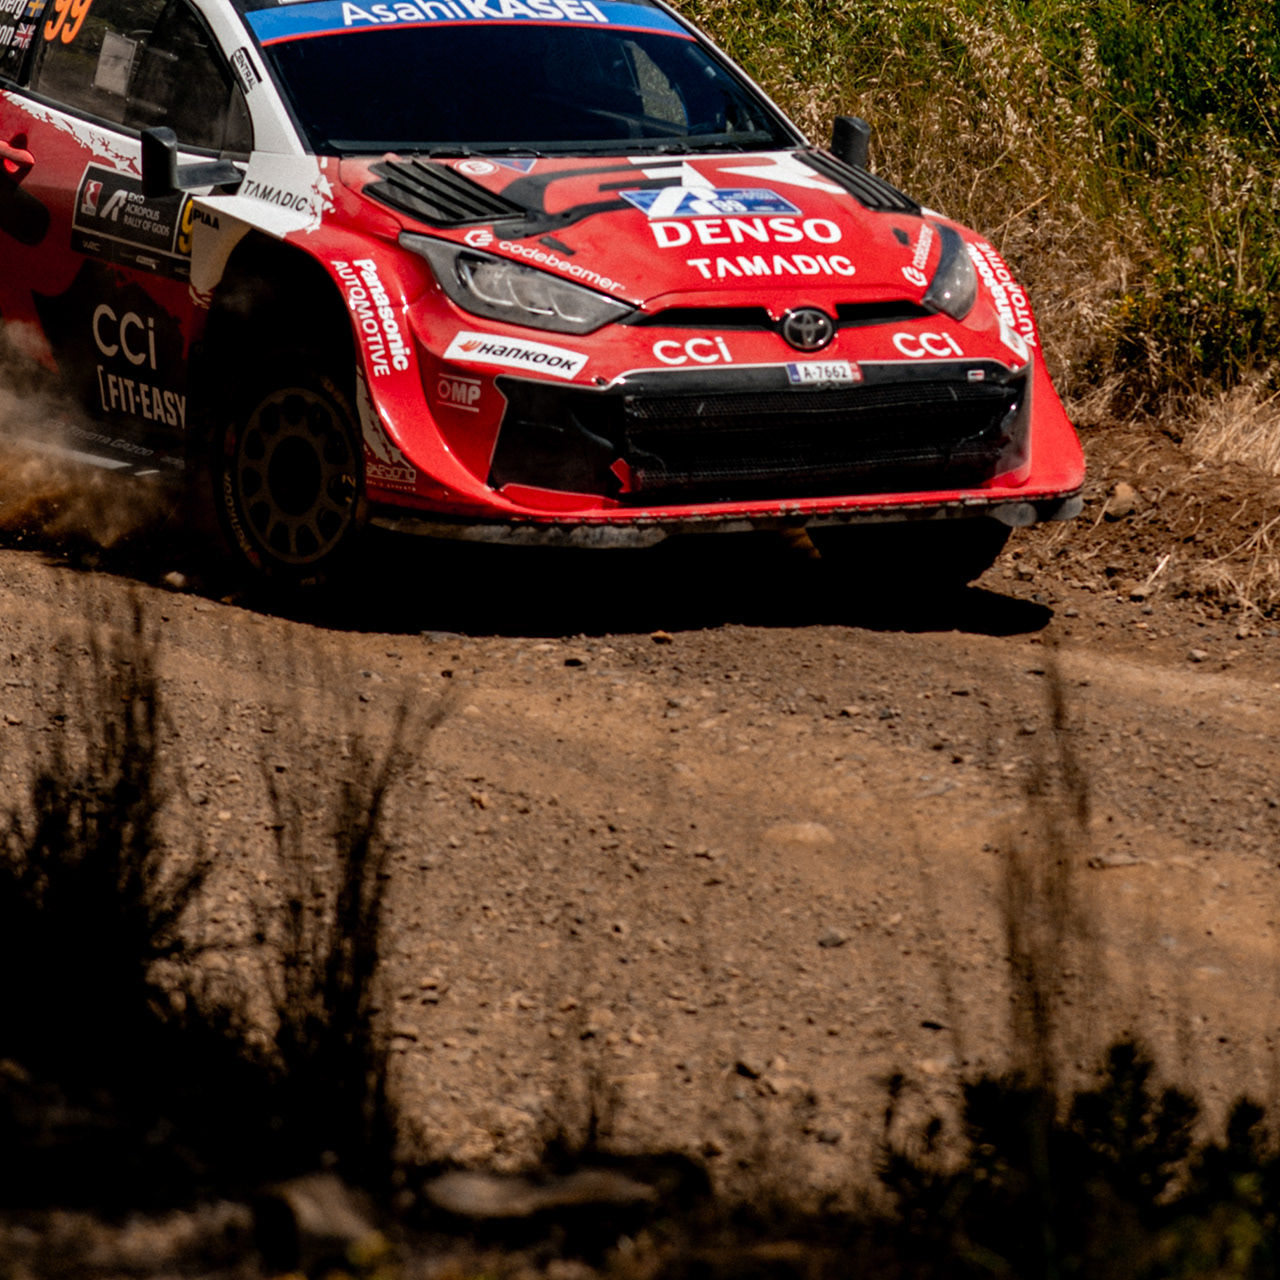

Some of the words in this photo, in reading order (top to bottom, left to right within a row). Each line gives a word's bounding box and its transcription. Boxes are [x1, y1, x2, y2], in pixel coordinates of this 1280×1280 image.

[232, 48, 256, 91] CENTRAL
[128, 192, 145, 204] EKO
[244, 179, 308, 212] TAMADIC
[123, 215, 142, 228] RALLY
[142, 220, 152, 231] OF
[152, 223, 170, 237] GODS
[125, 203, 160, 221] ACROPOLIS
[193, 209, 220, 230] PIAA
[648, 217, 842, 249] DENSO
[498, 240, 623, 292] codebeamer
[686, 253, 856, 280] TAMADIC
[975, 241, 1037, 347] AUTOMOTIVE
[330, 260, 390, 377] AUTOMOTIVE
[352, 259, 411, 371] Panasonic
[803, 366, 847, 378] A-7662
[438, 380, 481, 405] OMP
